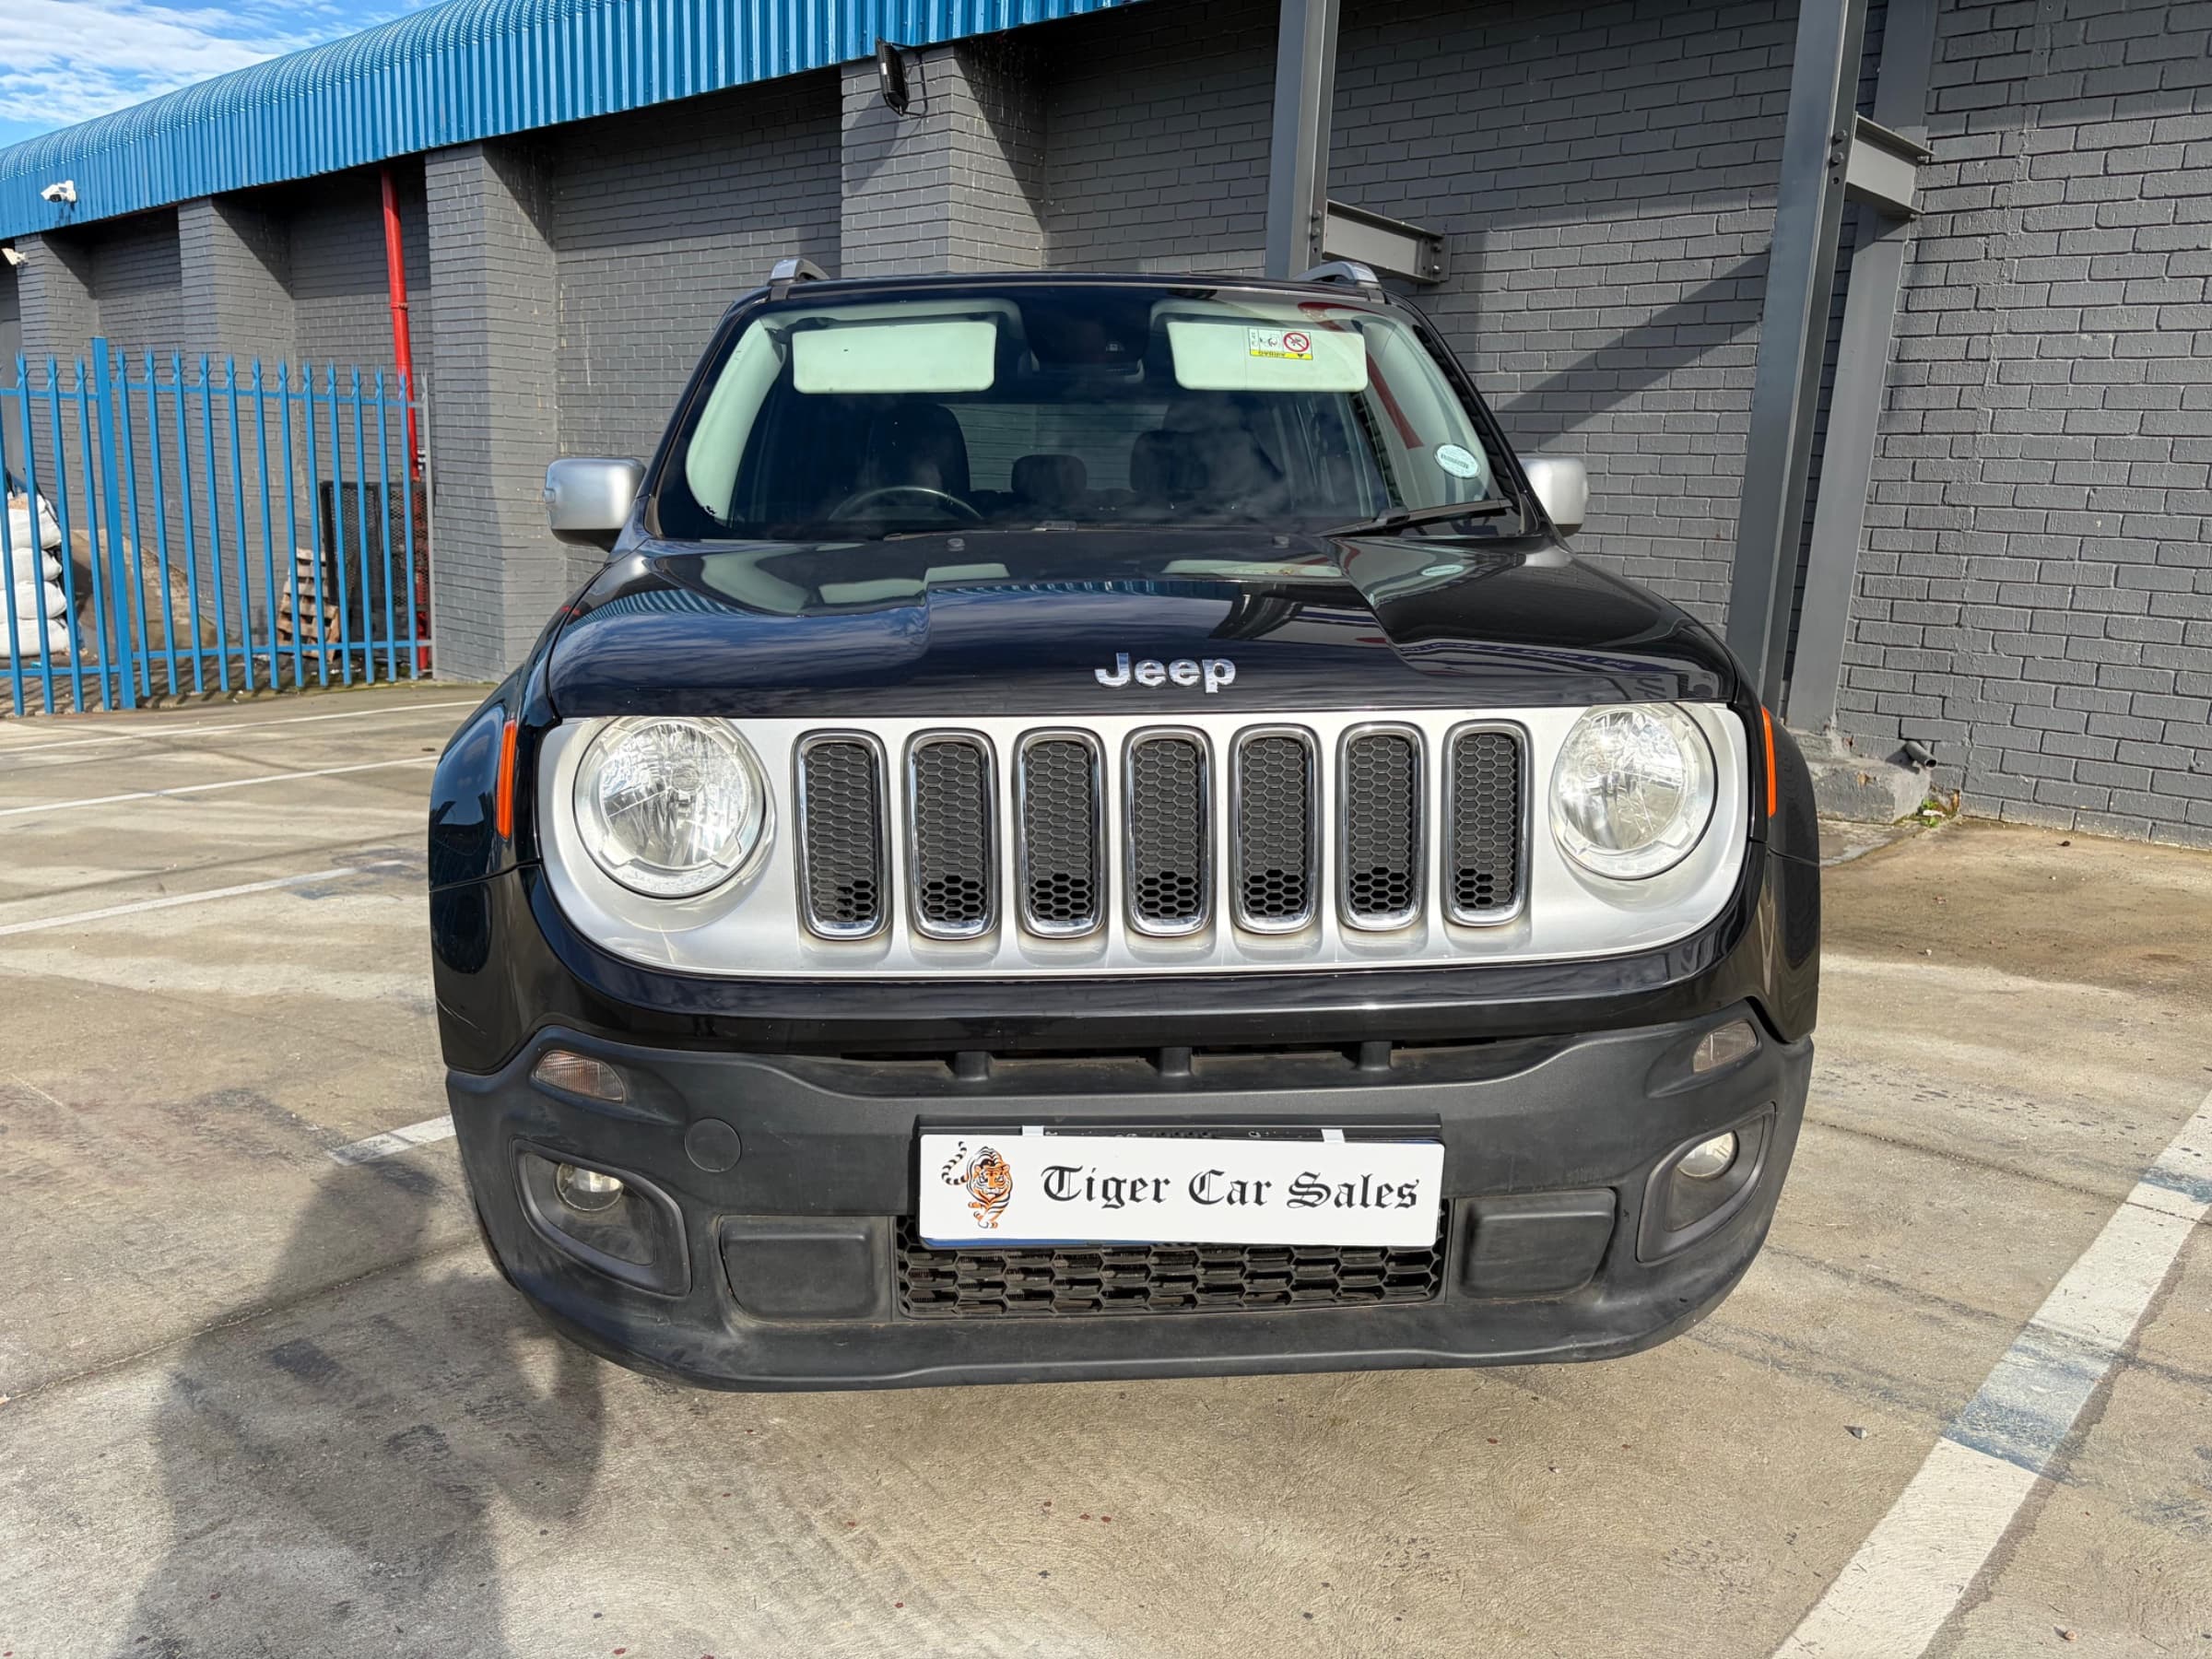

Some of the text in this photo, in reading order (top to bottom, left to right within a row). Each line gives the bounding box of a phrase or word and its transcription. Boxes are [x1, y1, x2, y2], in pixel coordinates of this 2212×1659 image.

[1094, 652, 1237, 694] Jeep
[1041, 1165, 1420, 1209] Tiger Car Sales
